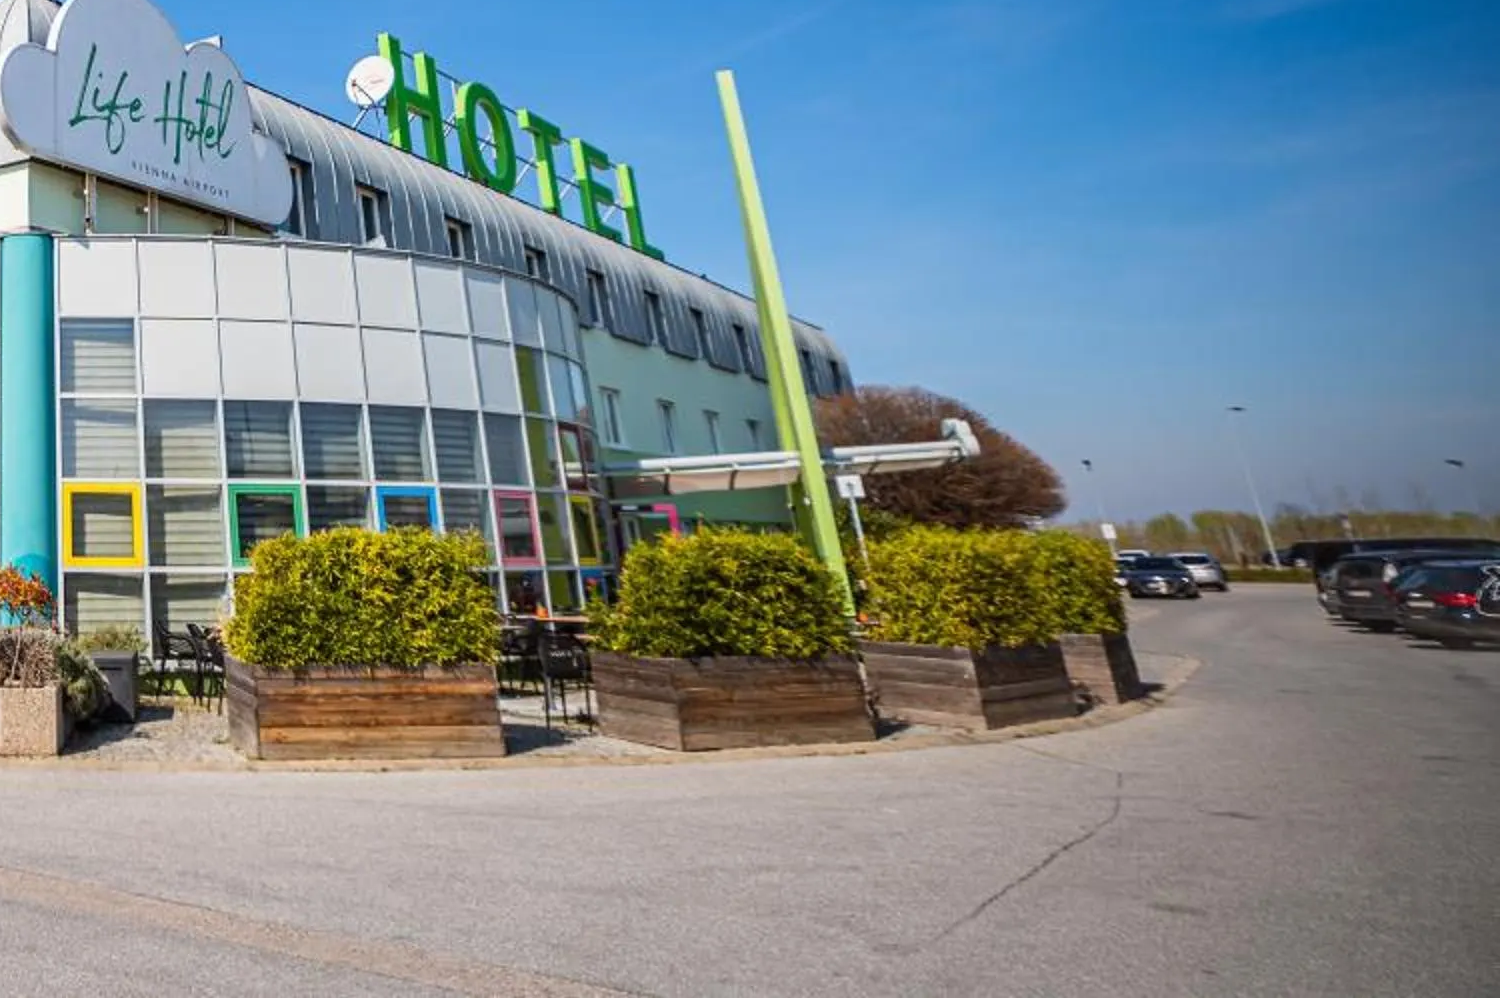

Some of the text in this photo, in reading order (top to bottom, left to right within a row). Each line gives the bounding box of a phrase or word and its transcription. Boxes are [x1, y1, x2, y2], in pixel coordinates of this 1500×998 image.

[68, 43, 237, 165] Life Hotel
[376, 31, 665, 262] HOTEL
